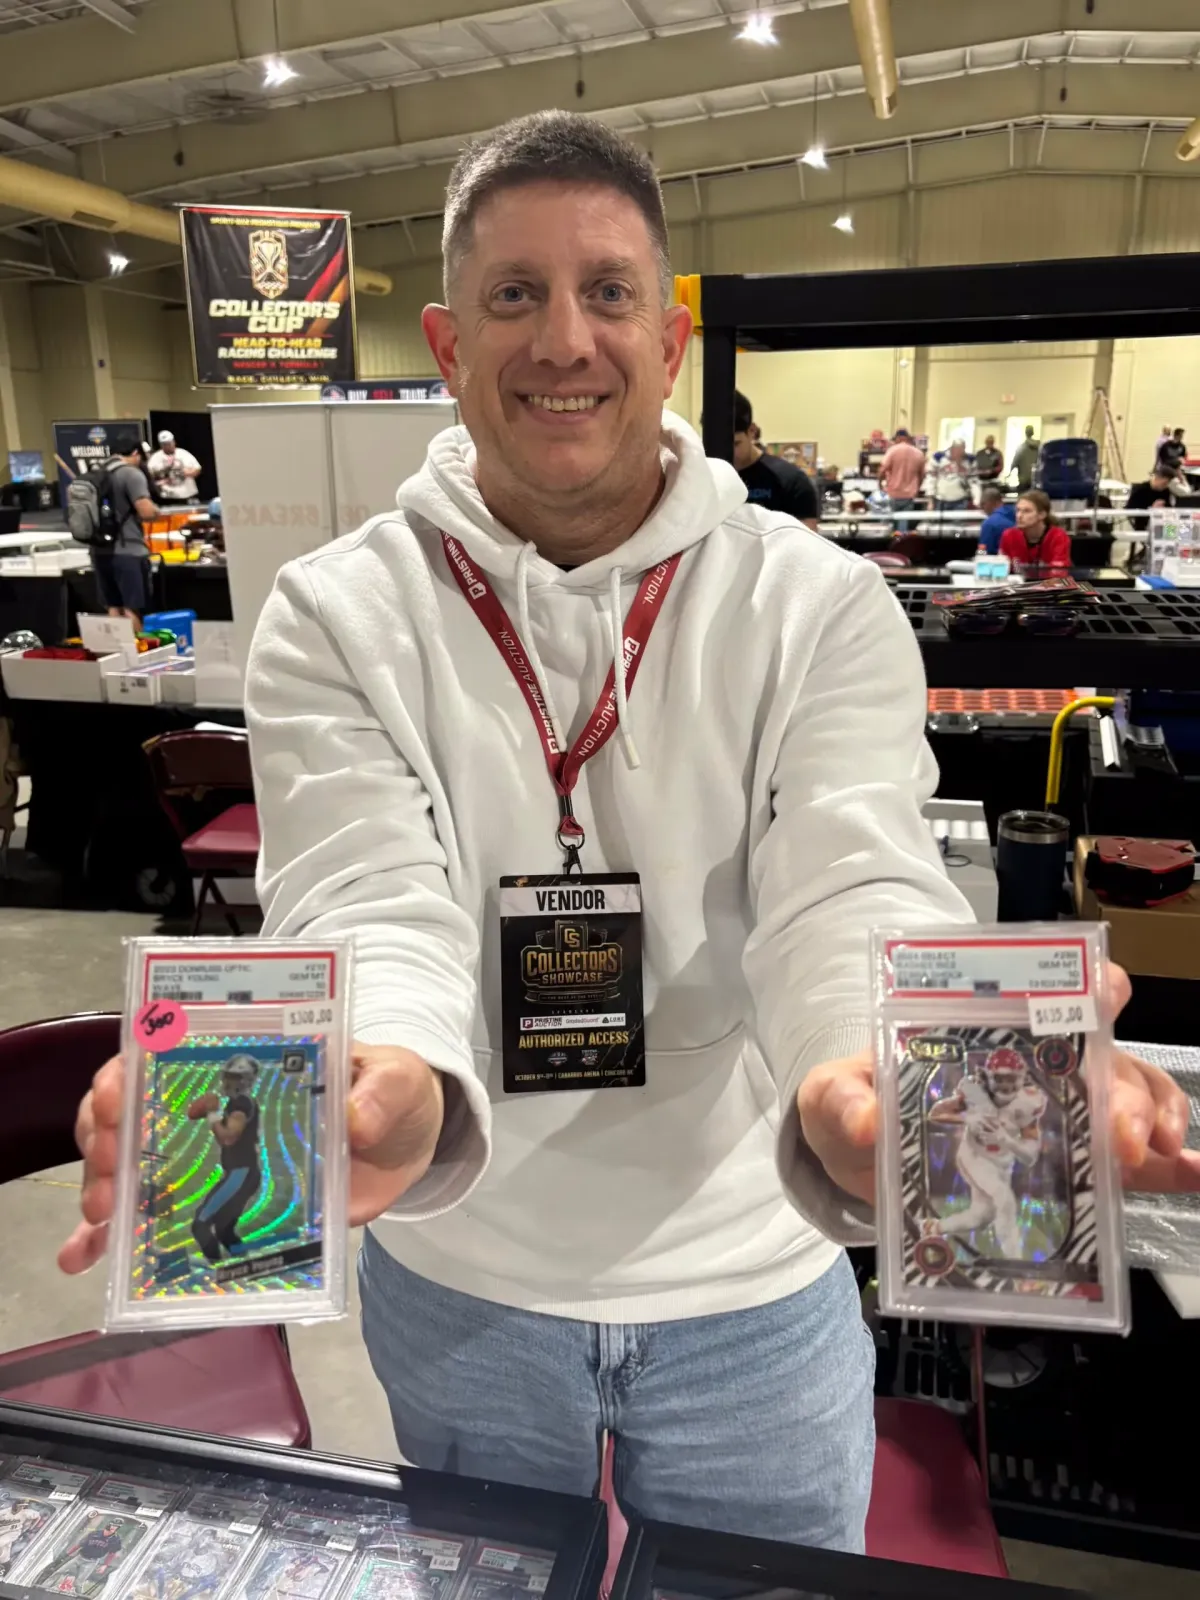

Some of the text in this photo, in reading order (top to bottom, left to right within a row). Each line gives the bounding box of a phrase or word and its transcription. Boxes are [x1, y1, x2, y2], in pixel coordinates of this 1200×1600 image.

[247, 316, 304, 333] CUP
[233, 337, 322, 348] HEAD-TO-HEAD
[217, 347, 338, 359] RACING CHALLENGE
[70, 445, 105, 458] WELCOME
[447, 539, 478, 586] PRISTINE
[498, 631, 534, 683] AUCTION
[578, 701, 616, 756] AUCTION
[535, 889, 606, 911] VENDOR
[527, 948, 618, 976] COLLECTORS
[541, 971, 604, 985] SHOWCASE
[518, 1031, 629, 1049] AUTHORIZED ACCESS
